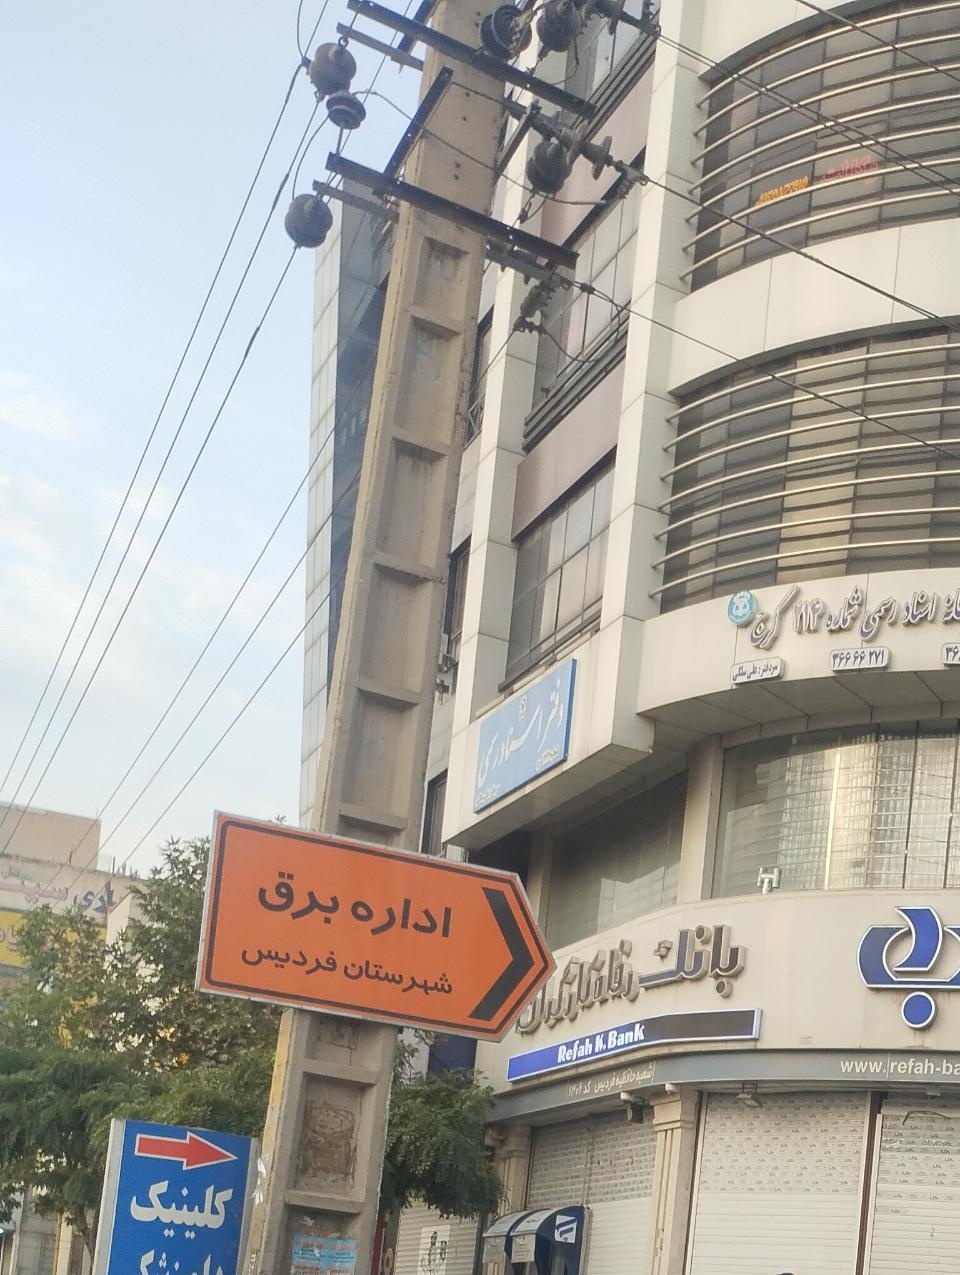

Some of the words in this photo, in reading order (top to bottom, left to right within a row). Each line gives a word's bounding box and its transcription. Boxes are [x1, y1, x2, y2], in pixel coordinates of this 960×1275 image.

[749, 583, 800, 650] کرج
[825, 584, 862, 632] شماره
[859, 596, 897, 642] رسمی
[902, 590, 937, 625] اسناد
[258, 871, 340, 925] برق
[351, 898, 452, 938] اداره
[241, 947, 338, 976] فردیس
[344, 959, 453, 996] شهرستان
[639, 924, 748, 999] بانک
[557, 1039, 593, 1063] Refah
[607, 1024, 645, 1050] Bank
[130, 1180, 233, 1240] کلینیک
